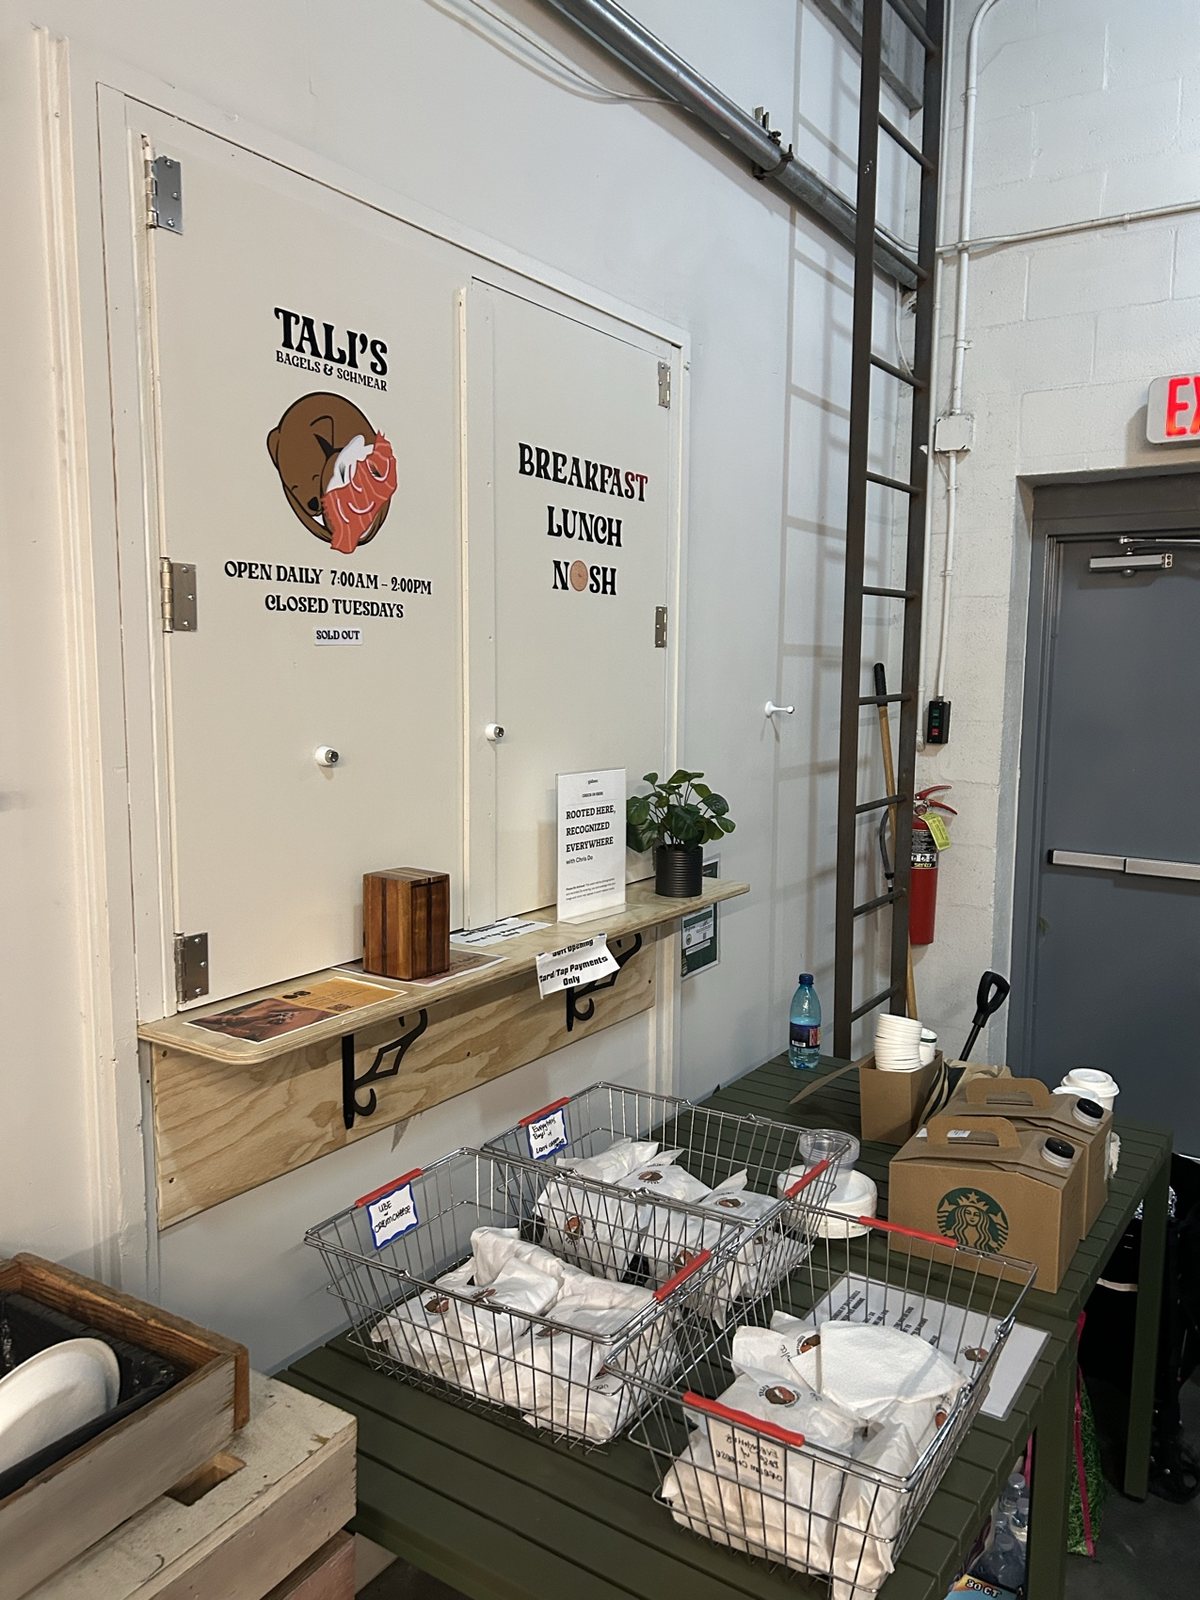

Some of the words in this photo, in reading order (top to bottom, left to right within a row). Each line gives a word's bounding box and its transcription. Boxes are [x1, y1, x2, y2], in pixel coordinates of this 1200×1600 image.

[274, 307, 388, 376] TALI'S
[276, 350, 321, 373] BAGELS
[323, 363, 334, 376] &
[337, 368, 388, 392] SCHMEAR
[518, 442, 649, 502] BREAKFAST
[547, 505, 623, 548] LUNCH
[224, 560, 273, 581] OPEN
[276, 565, 324, 585] DAILY
[330, 570, 379, 590] 7:00AM
[391, 576, 433, 595] 2:00PM
[265, 594, 329, 614] CLOSED
[332, 599, 404, 619] TUESDAYS
[316, 630, 340, 640] SOLD
[341, 630, 360, 640] OUT
[566, 807, 595, 820] ROOTED
[596, 804, 616, 815] HERE,
[566, 821, 610, 836] RECOGNIZED
[566, 836, 614, 852] EVERYWHERE
[556, 966, 569, 976] Tap
[569, 956, 609, 971] Payments
[563, 975, 580, 986] Only
